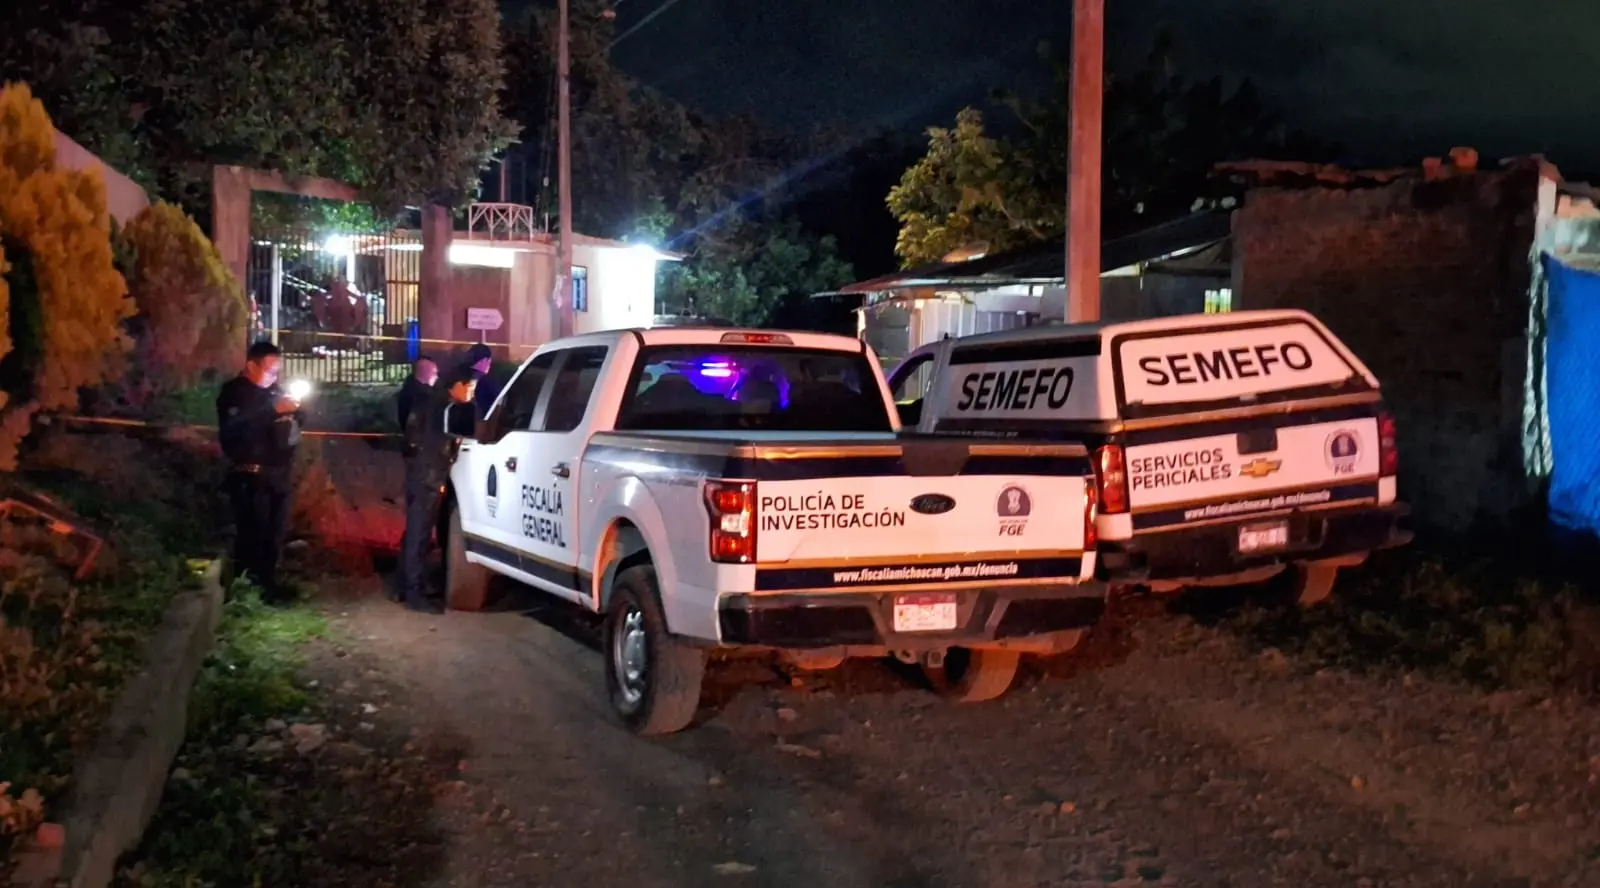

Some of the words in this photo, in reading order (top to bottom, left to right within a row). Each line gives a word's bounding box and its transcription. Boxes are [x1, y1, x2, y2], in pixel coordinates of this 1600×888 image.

[1139, 341, 1314, 387] SEMEFO
[957, 366, 1074, 411] SEMEFO
[1131, 448, 1224, 474] SERVICIOS
[1132, 463, 1232, 491] PERICIALES
[521, 482, 564, 516] FISCALÍA
[762, 490, 836, 512] POLICÍA
[841, 494, 865, 510] DE
[522, 513, 567, 548] GENERAL
[761, 507, 905, 531] INVESTIGACIÓN
[998, 523, 1026, 536] FGE
[833, 562, 1018, 583] www.fiscaliamichoacan.gob.mx/denuncia
